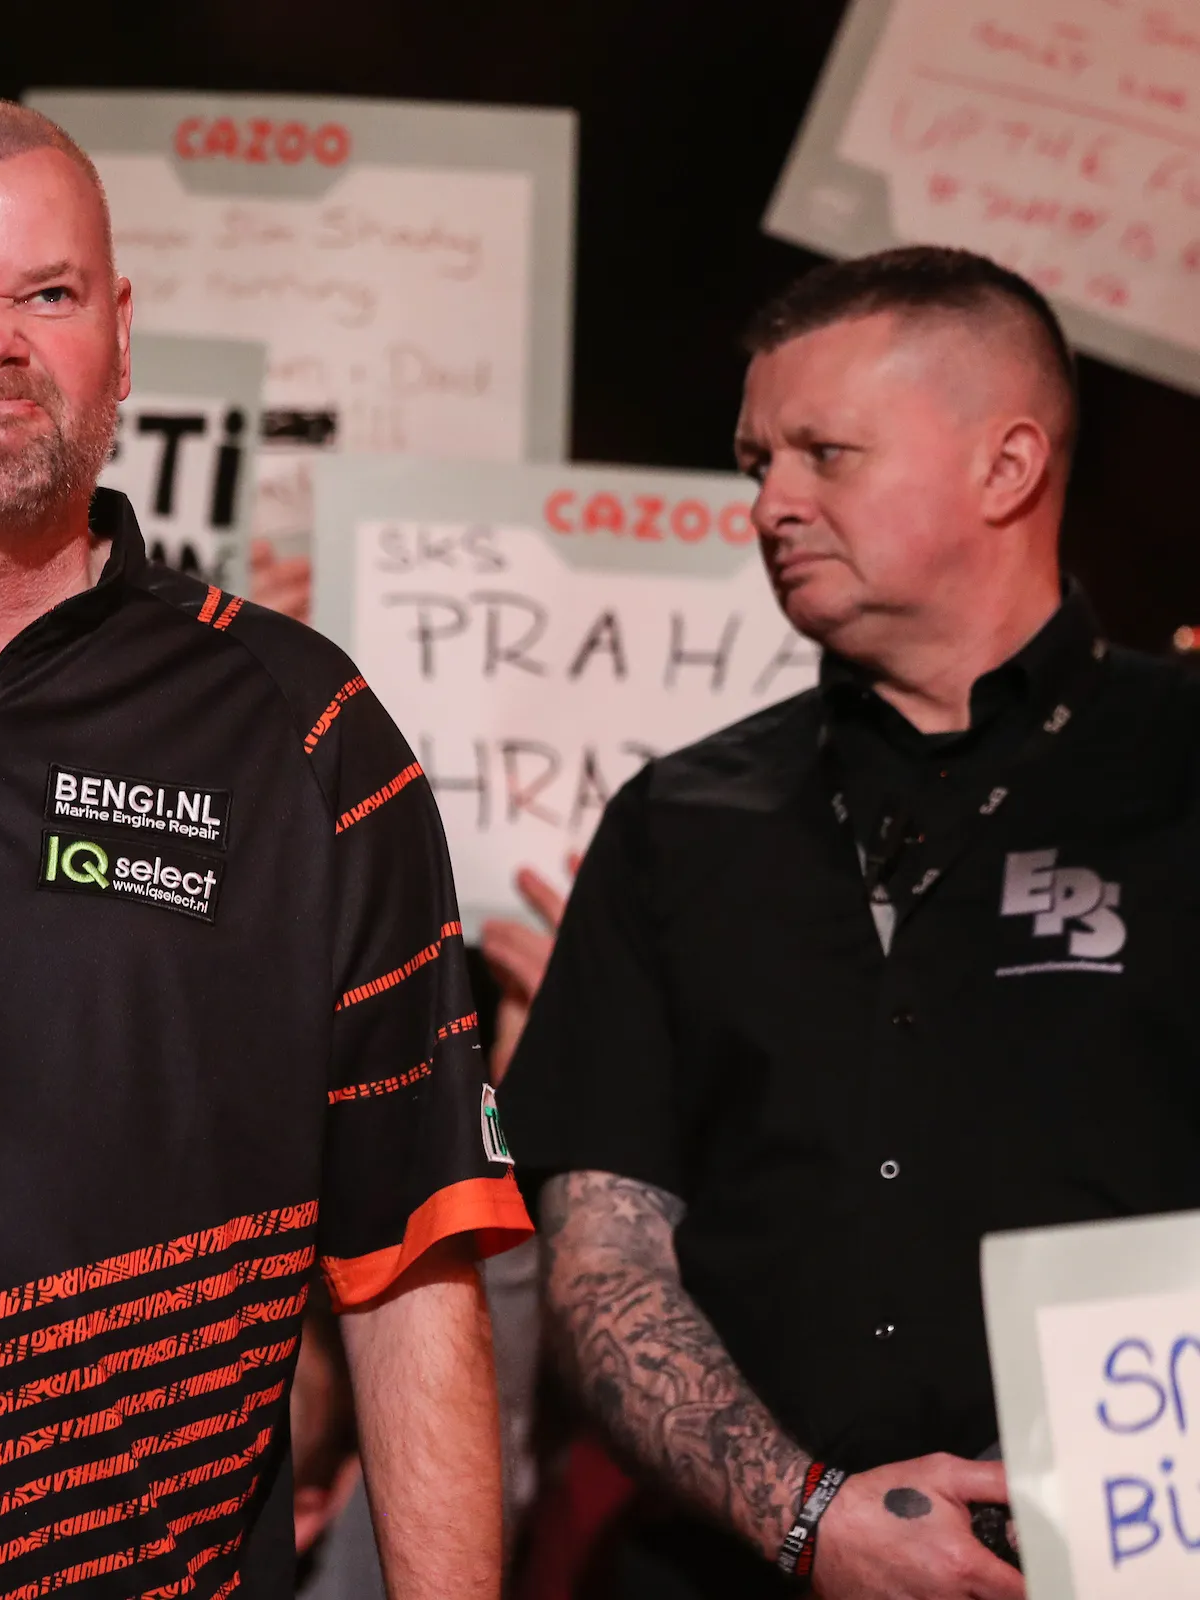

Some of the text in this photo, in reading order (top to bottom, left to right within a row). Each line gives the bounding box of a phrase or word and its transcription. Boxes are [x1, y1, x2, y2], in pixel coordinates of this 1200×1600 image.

[173, 117, 352, 167] CAZOO
[544, 489, 758, 546] CAZOO
[54, 771, 221, 827] BENGI.NL
[419, 730, 666, 833] HRA
[54, 800, 220, 841] Marine Engine Repair
[46, 836, 217, 899] IQ select
[112, 879, 209, 914] www.iqselect.nl
[1000, 848, 1127, 959] EPS
